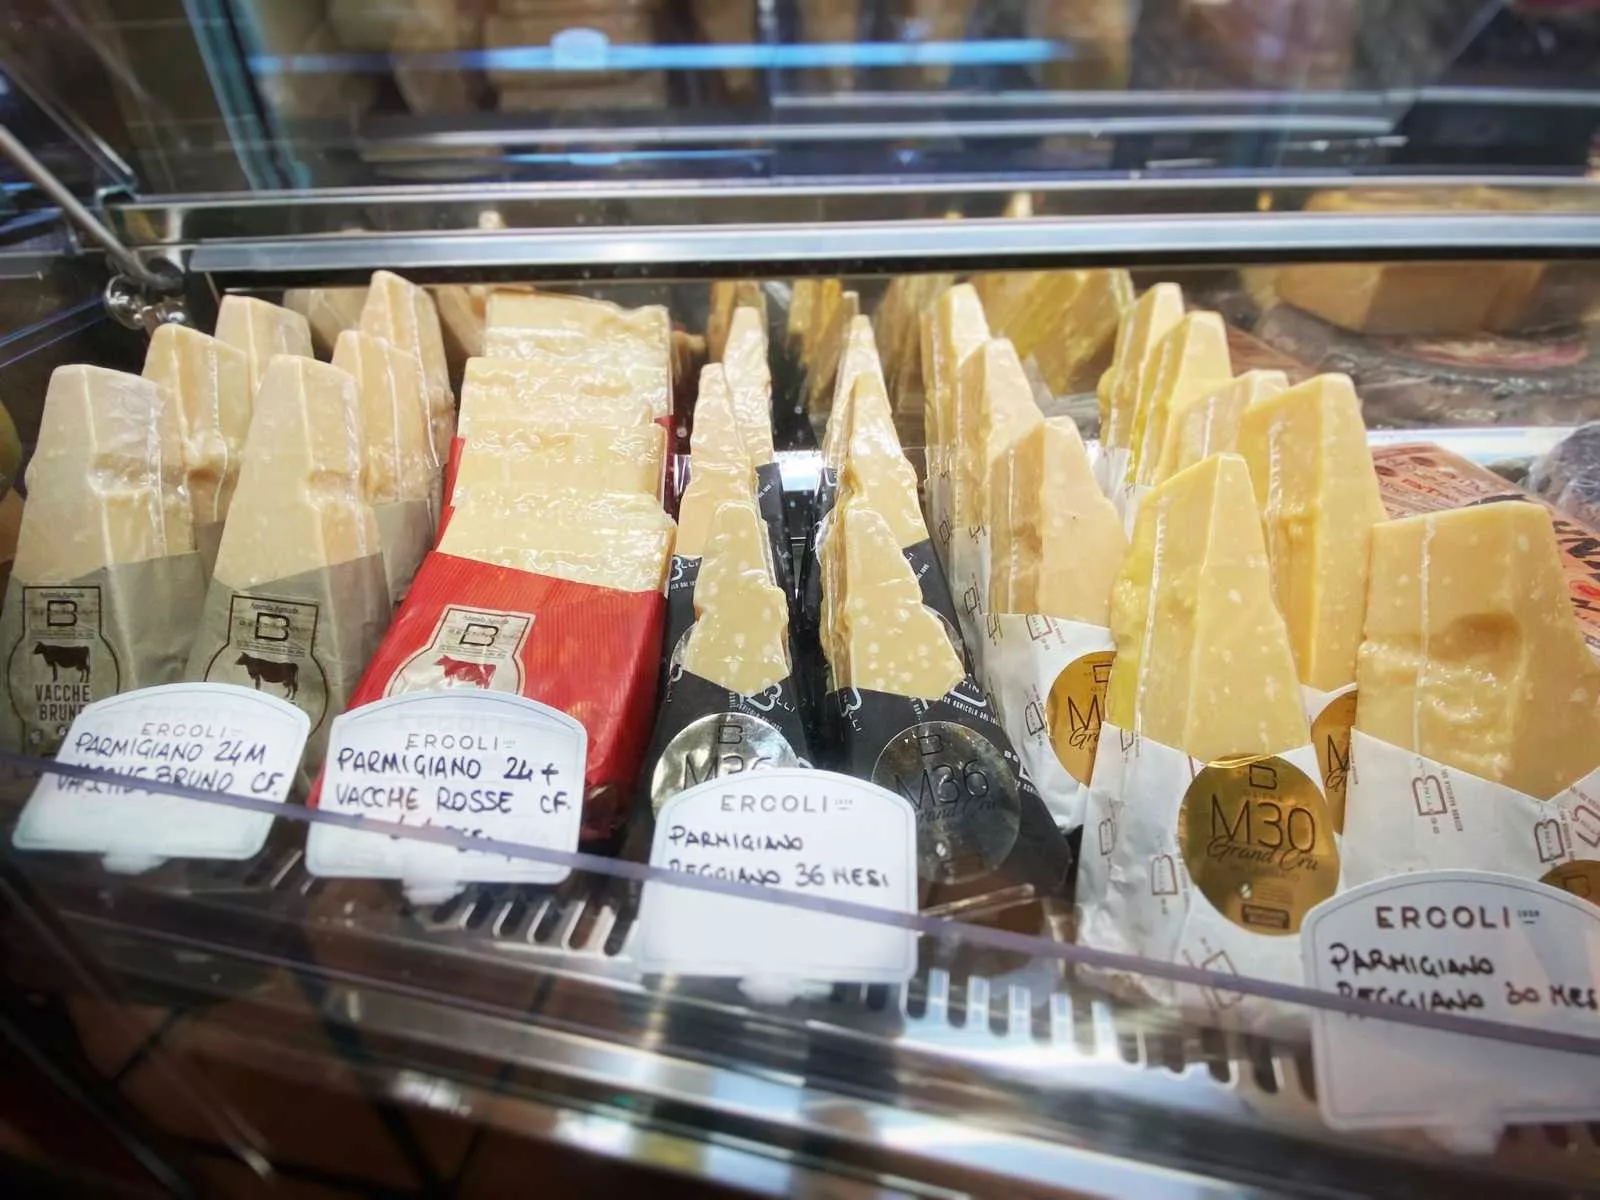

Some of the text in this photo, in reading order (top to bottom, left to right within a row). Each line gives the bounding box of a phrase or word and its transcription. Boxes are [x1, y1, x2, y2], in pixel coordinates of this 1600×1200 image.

[34, 684, 90, 702] VACCHE
[140, 722, 225, 738] ERCOLI
[405, 733, 499, 750] ERCOLI
[75, 732, 203, 763] PARMIGIANO
[214, 740, 266, 764] 24M
[337, 748, 483, 780] PARMIGIANO
[894, 757, 989, 810] M36
[335, 785, 420, 811] VACCHE
[436, 787, 514, 814] ROSSE
[720, 795, 828, 813] ERCOLI
[1211, 793, 1315, 853] M30
[668, 825, 804, 852] PARMIGIANO
[1207, 834, 1319, 871] Grand Cru
[795, 863, 825, 887] 36
[1375, 906, 1510, 929] ERCOLI
[1328, 942, 1495, 978] PARMIGIANO
[1549, 983, 1600, 1012] MES
